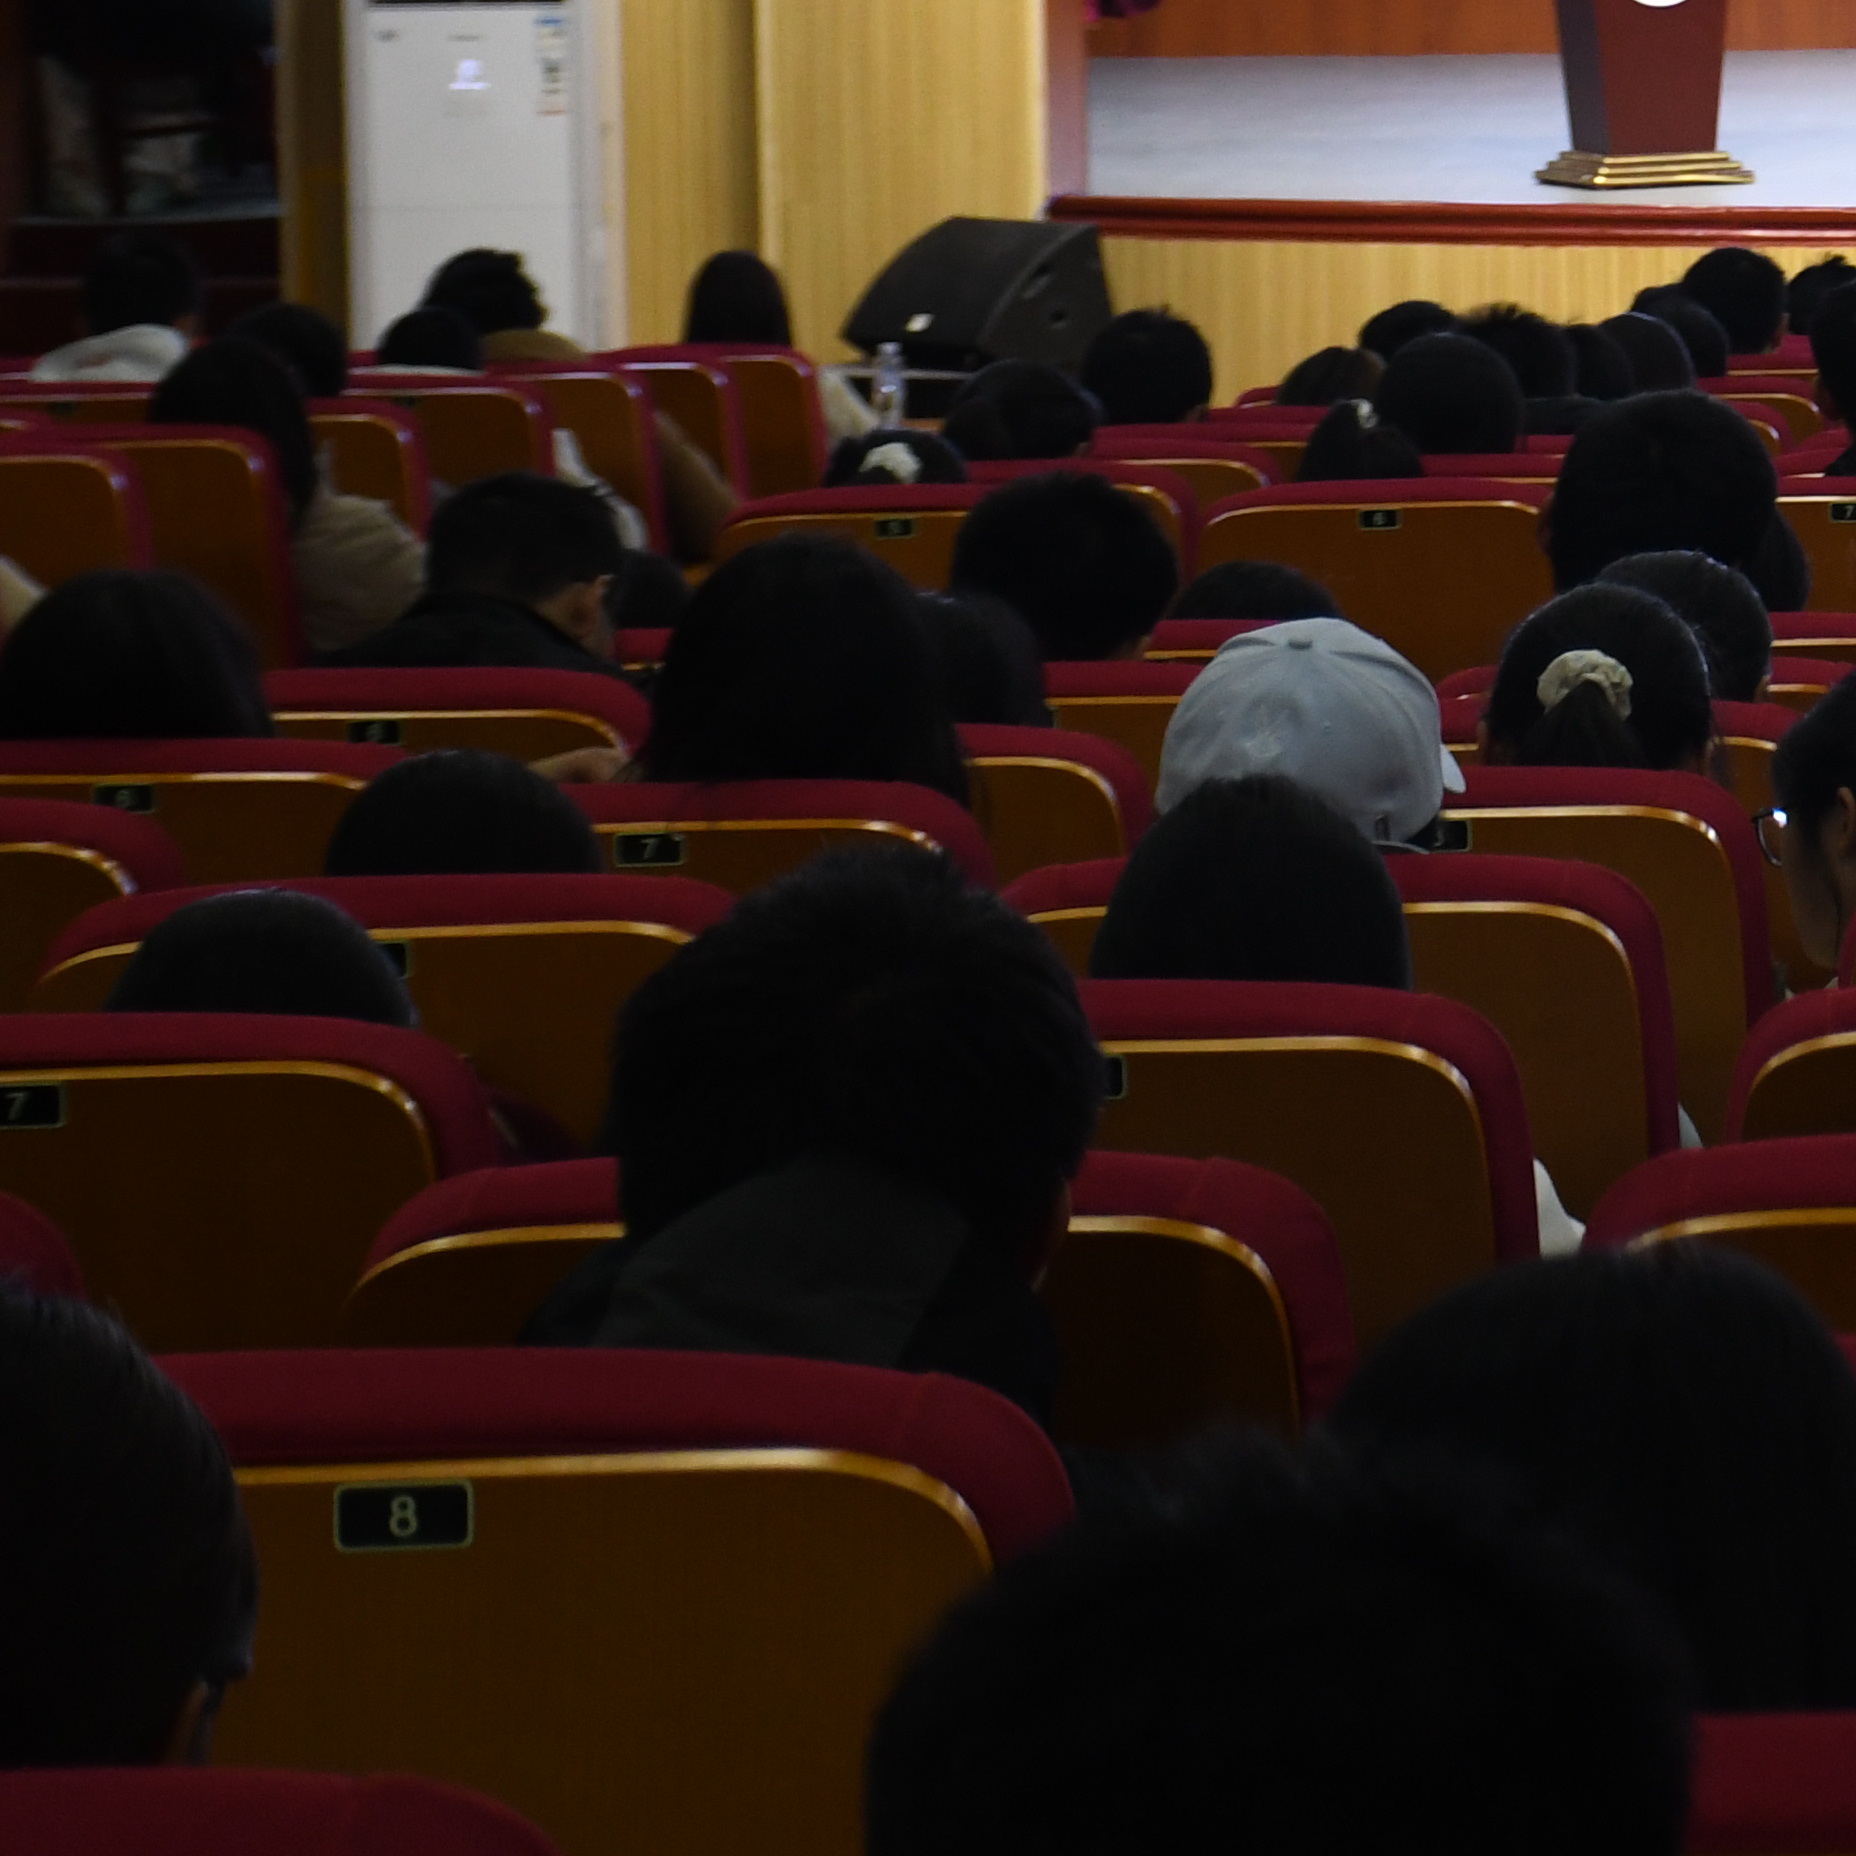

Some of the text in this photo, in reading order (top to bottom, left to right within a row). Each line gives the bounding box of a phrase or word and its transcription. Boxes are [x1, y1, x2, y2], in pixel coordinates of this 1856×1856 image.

[641, 838, 659, 860] 7
[6, 1091, 30, 1120] 7
[389, 1493, 418, 1537] 8
